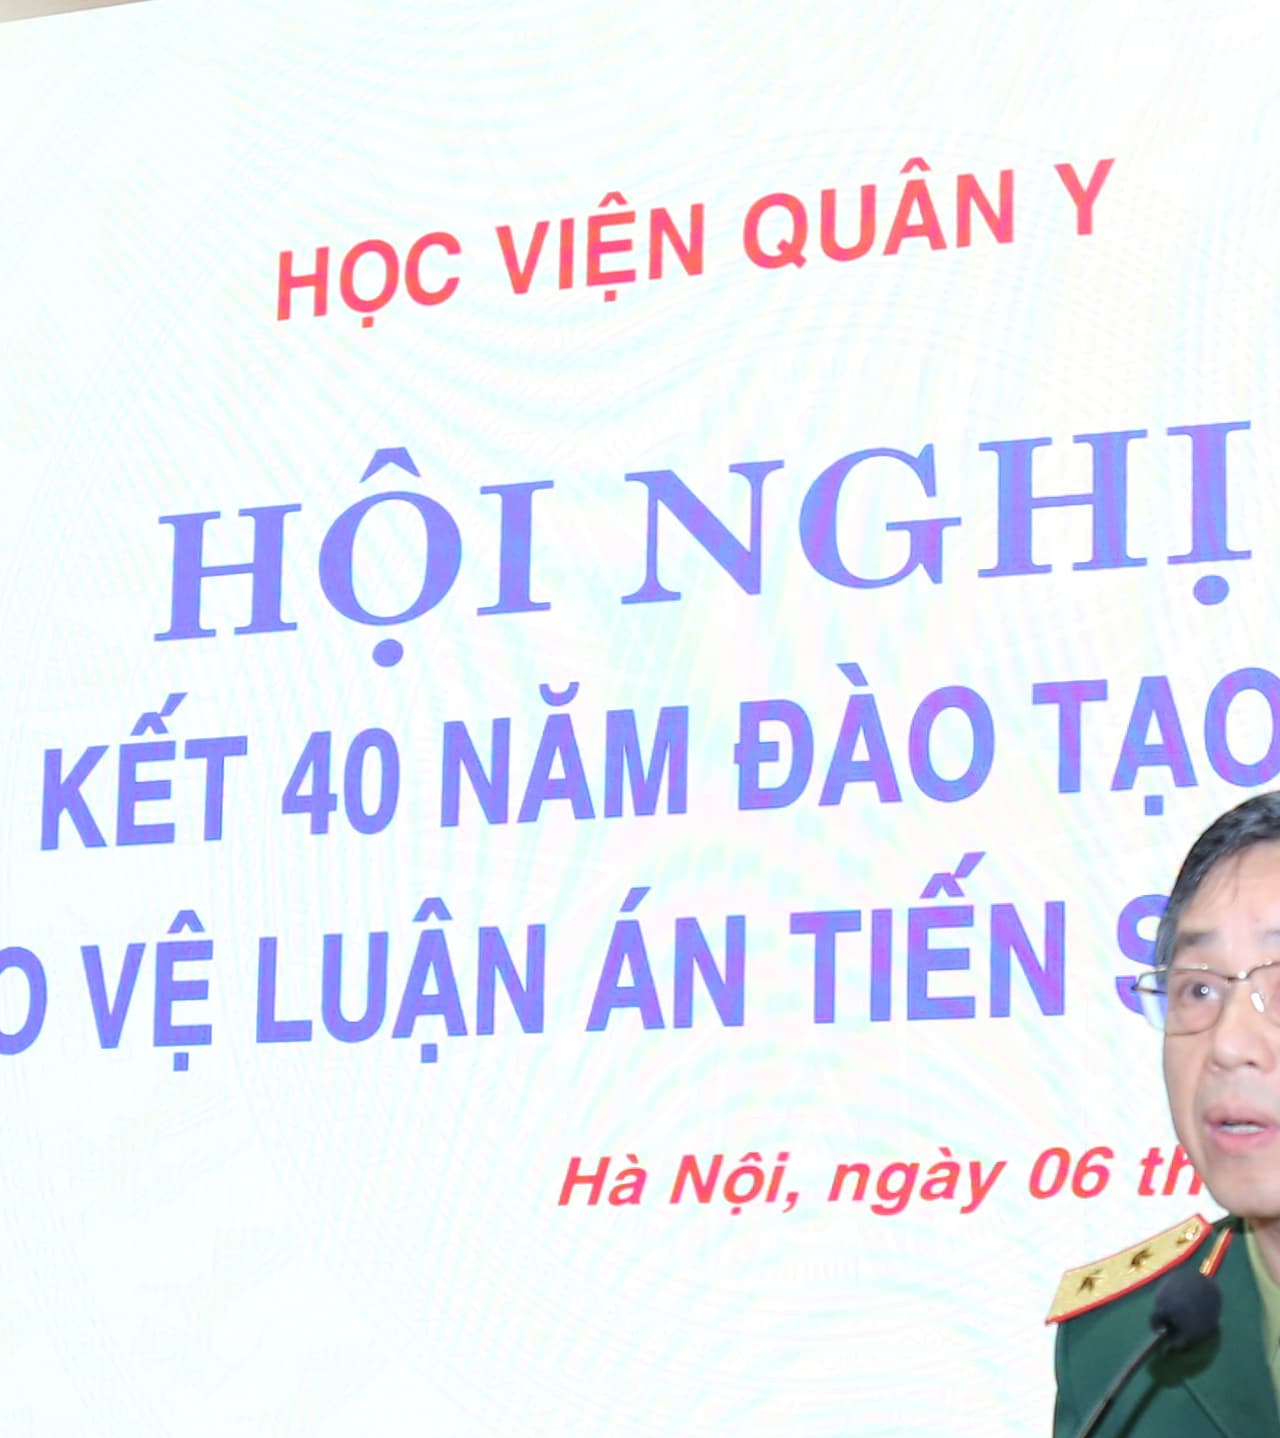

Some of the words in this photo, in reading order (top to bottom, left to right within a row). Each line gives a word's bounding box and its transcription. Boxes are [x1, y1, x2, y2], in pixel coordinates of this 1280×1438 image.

[277, 232, 461, 328] HỌC
[496, 192, 704, 302] VIỆN
[744, 157, 1013, 269] QUÂN
[1056, 159, 1114, 235] Y
[155, 447, 554, 667] HỘI
[621, 421, 1251, 605] NGHỊ
[41, 693, 247, 851] KẾT
[282, 728, 399, 835] 40
[441, 682, 689, 827] NĂM
[735, 663, 994, 810] ĐÀO
[81, 910, 213, 1072] VỆ
[256, 897, 546, 1063] LUẬN
[586, 886, 746, 1032] ÁN
[790, 852, 1065, 1023] TIẾN
[559, 1154, 644, 1206] Hà
[670, 1152, 799, 1215] Nội,
[829, 1150, 1004, 1216] ngày
[1030, 1146, 1114, 1199] 06
